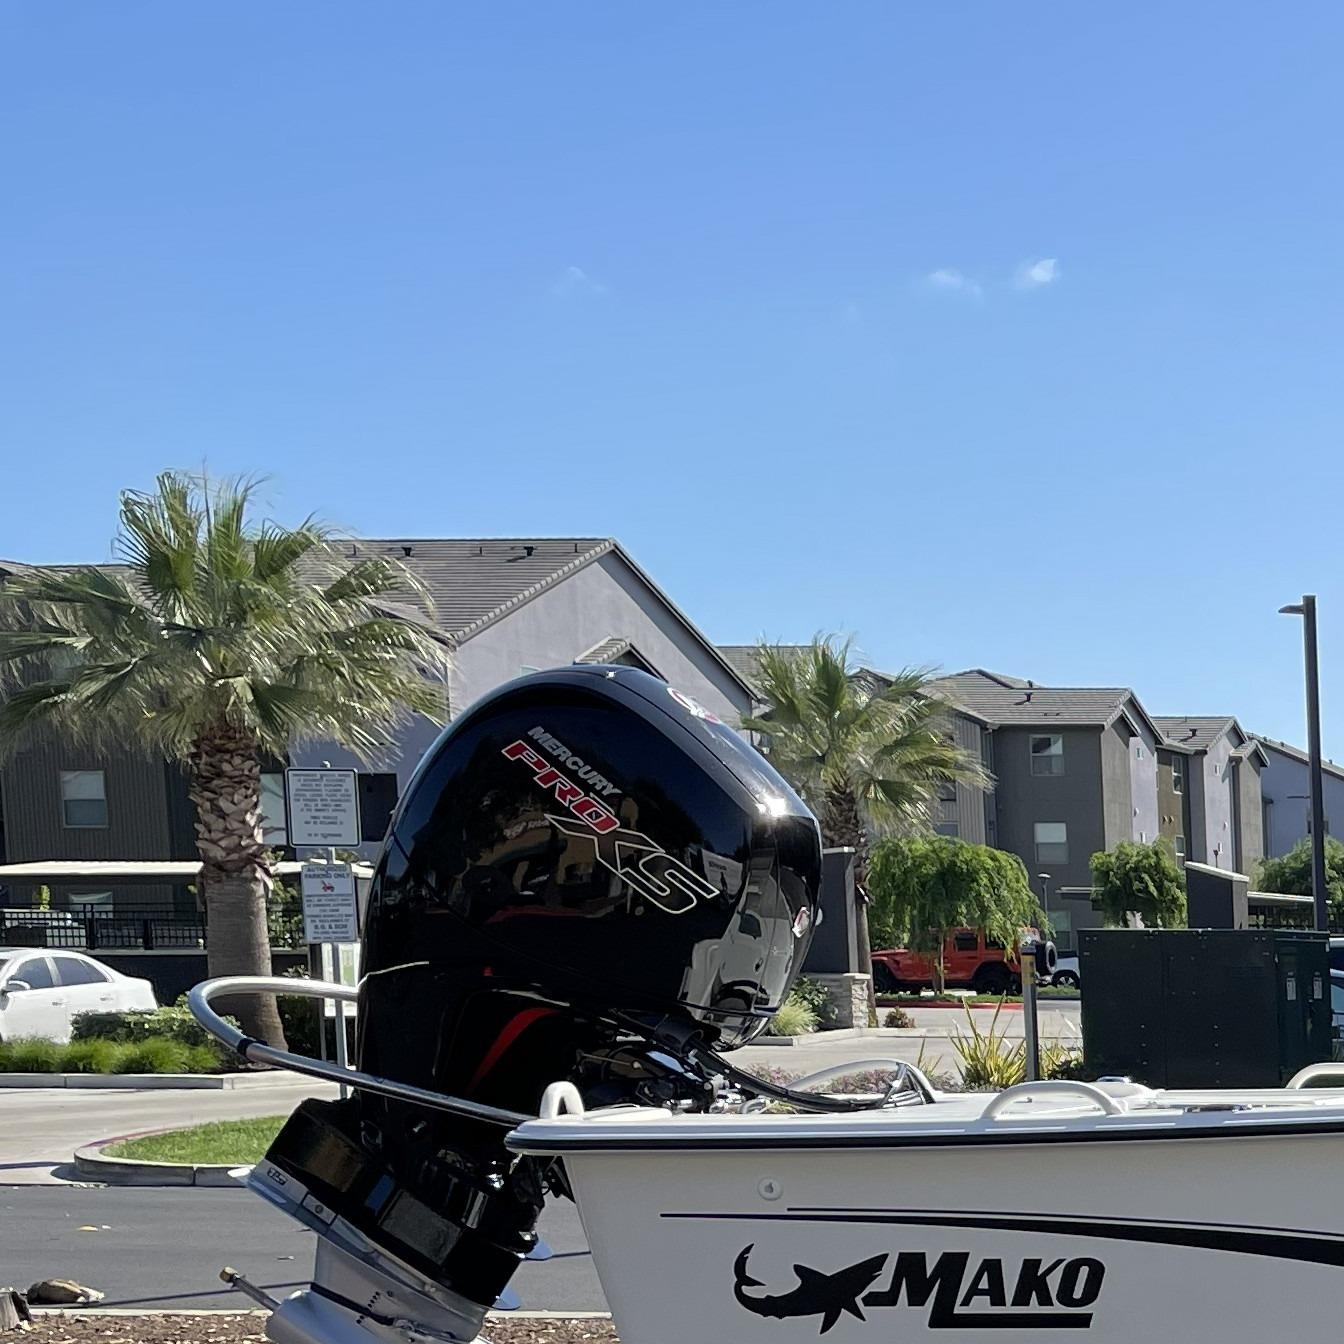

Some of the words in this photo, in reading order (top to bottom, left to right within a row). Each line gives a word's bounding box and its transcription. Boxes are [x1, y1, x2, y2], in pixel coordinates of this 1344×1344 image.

[501, 739, 621, 834] PRO
[527, 726, 623, 796] MERCURY
[543, 813, 721, 915] XS
[860, 1251, 1106, 1329] MAKO
